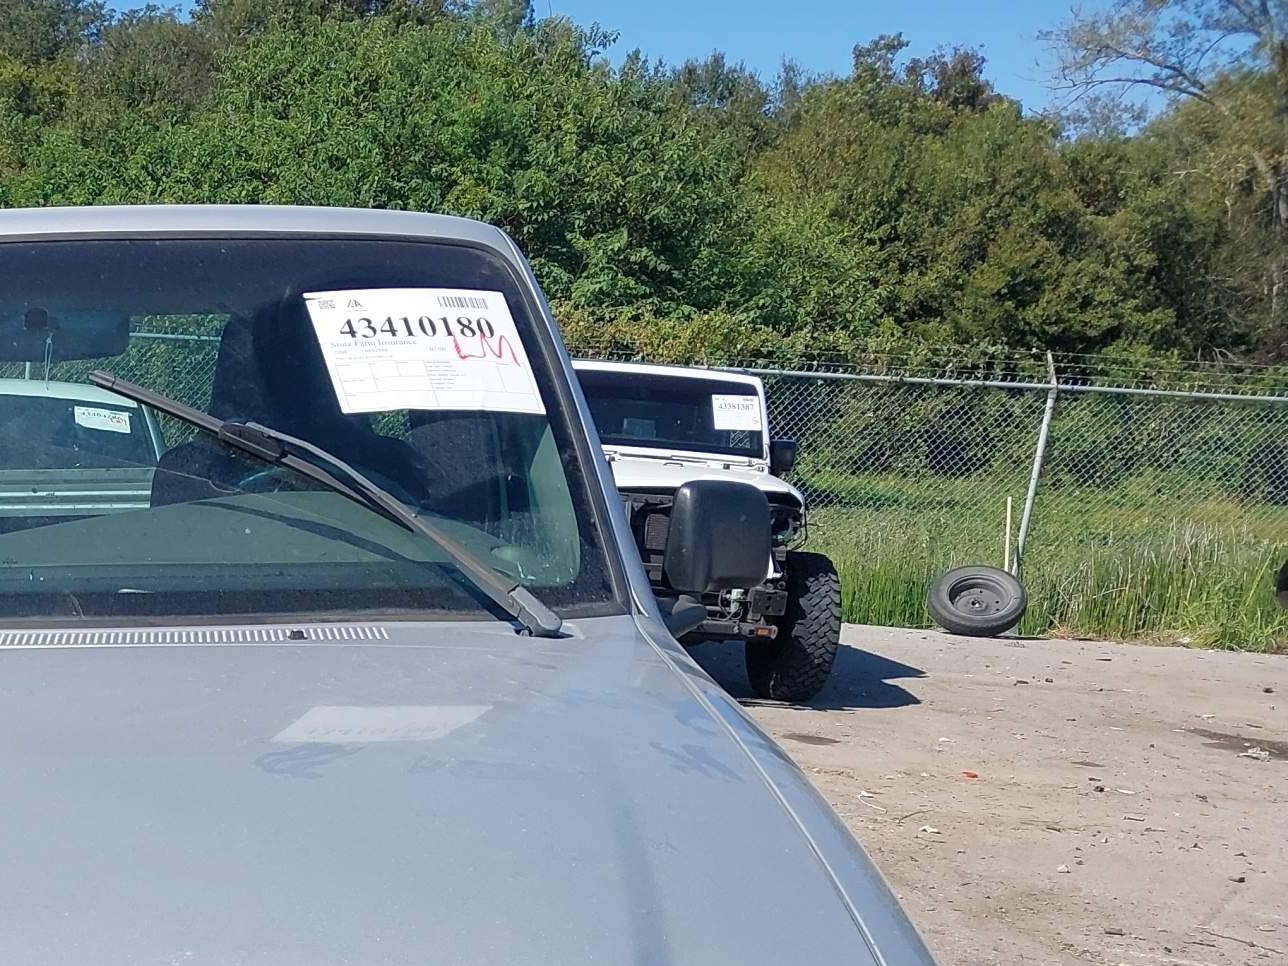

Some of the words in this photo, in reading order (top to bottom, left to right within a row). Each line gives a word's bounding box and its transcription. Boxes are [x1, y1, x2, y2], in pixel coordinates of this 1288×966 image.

[339, 315, 495, 339] 43410180
[354, 339, 376, 347] Farm
[377, 338, 418, 346] Insurance
